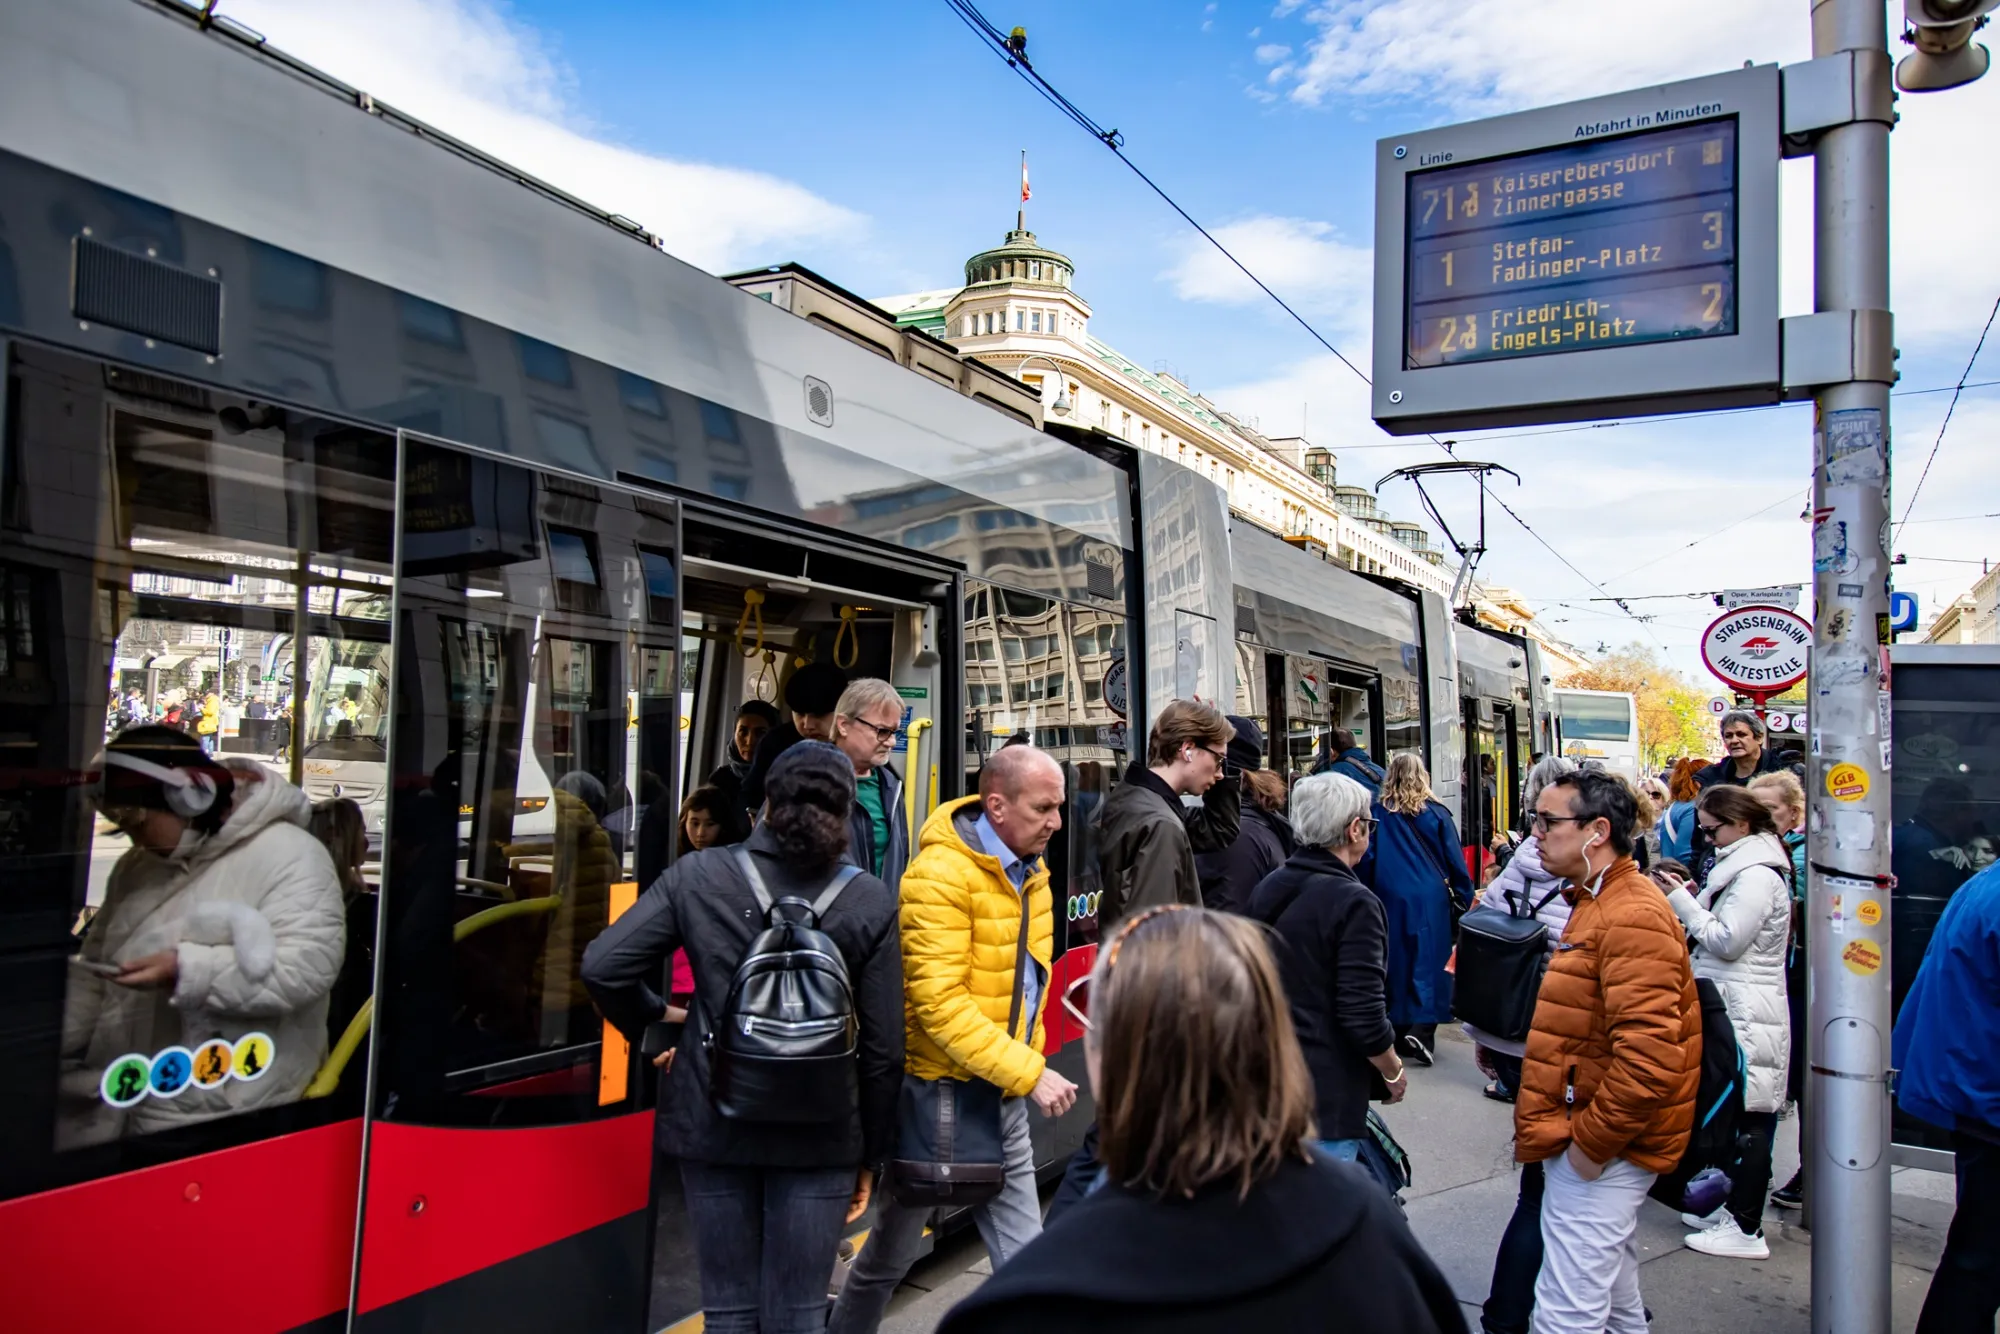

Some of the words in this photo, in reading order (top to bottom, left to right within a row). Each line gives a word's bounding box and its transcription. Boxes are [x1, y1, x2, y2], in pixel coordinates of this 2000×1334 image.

[1574, 117, 1632, 138] Abfahrt
[1637, 114, 1650, 127] in
[1656, 102, 1722, 123] Minuten
[1420, 152, 1453, 166] Linie
[1493, 146, 1675, 195] Kaiserebersdorf
[1422, 186, 1454, 224] 71
[1493, 182, 1624, 217] Zinnergasse
[1702, 211, 1722, 249] 3
[1493, 237, 1574, 261] Stefan-
[1493, 244, 1662, 283] Fadinger-Platz
[1441, 251, 1453, 286] 1
[1492, 298, 1610, 329] Friedrich-
[1702, 282, 1722, 322] 2
[1440, 317, 1456, 353] 2
[1492, 317, 1636, 350] Engels-Platz
[1715, 616, 1807, 645] STRASSENBAHN
[1718, 656, 1802, 680] HALTESTELLE
[1714, 701, 1724, 712] D
[1773, 716, 1782, 727] 2
[1833, 771, 1855, 786] GLB
